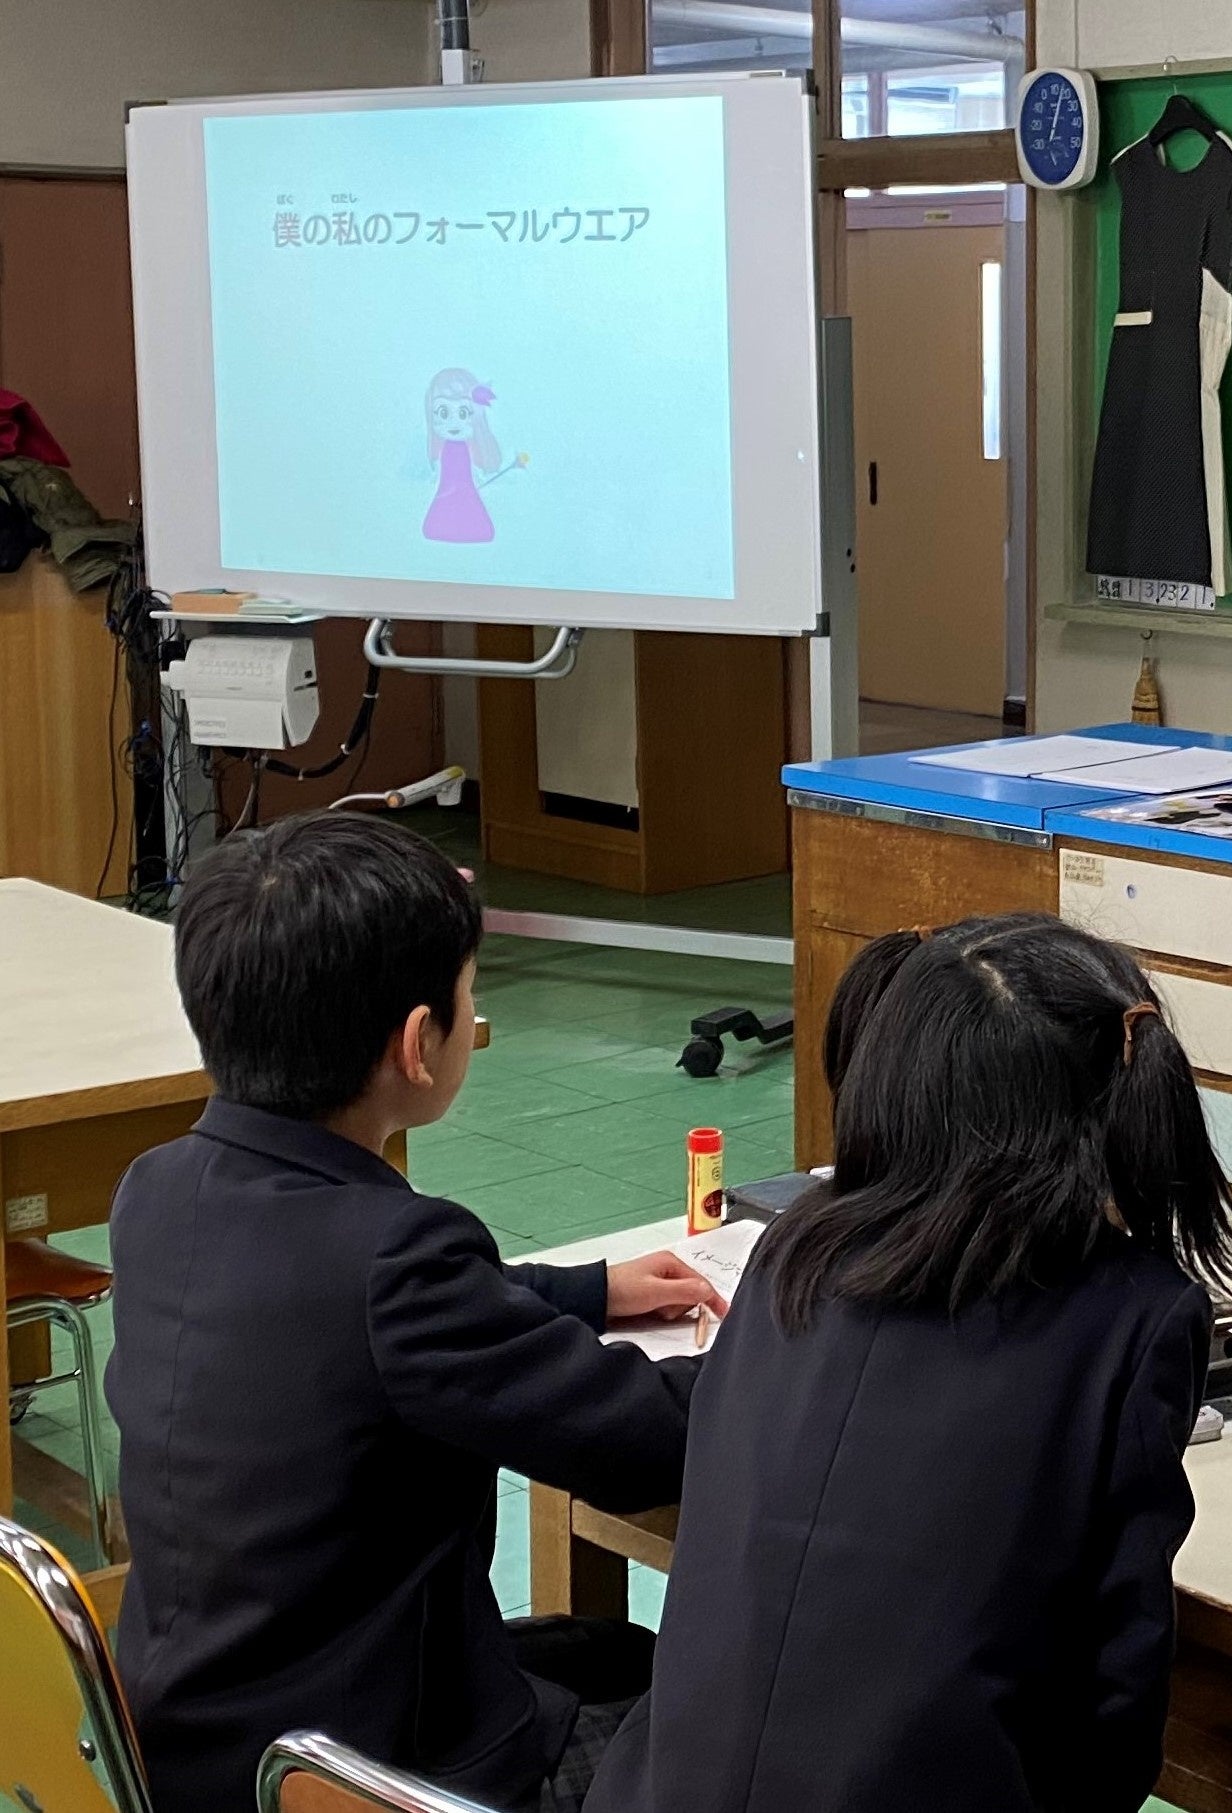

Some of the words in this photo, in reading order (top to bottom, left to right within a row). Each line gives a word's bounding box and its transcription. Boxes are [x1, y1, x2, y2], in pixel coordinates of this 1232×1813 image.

[331, 193, 358, 204] わたし
[273, 207, 650, 248] 僕の私のフォーマルウエア
